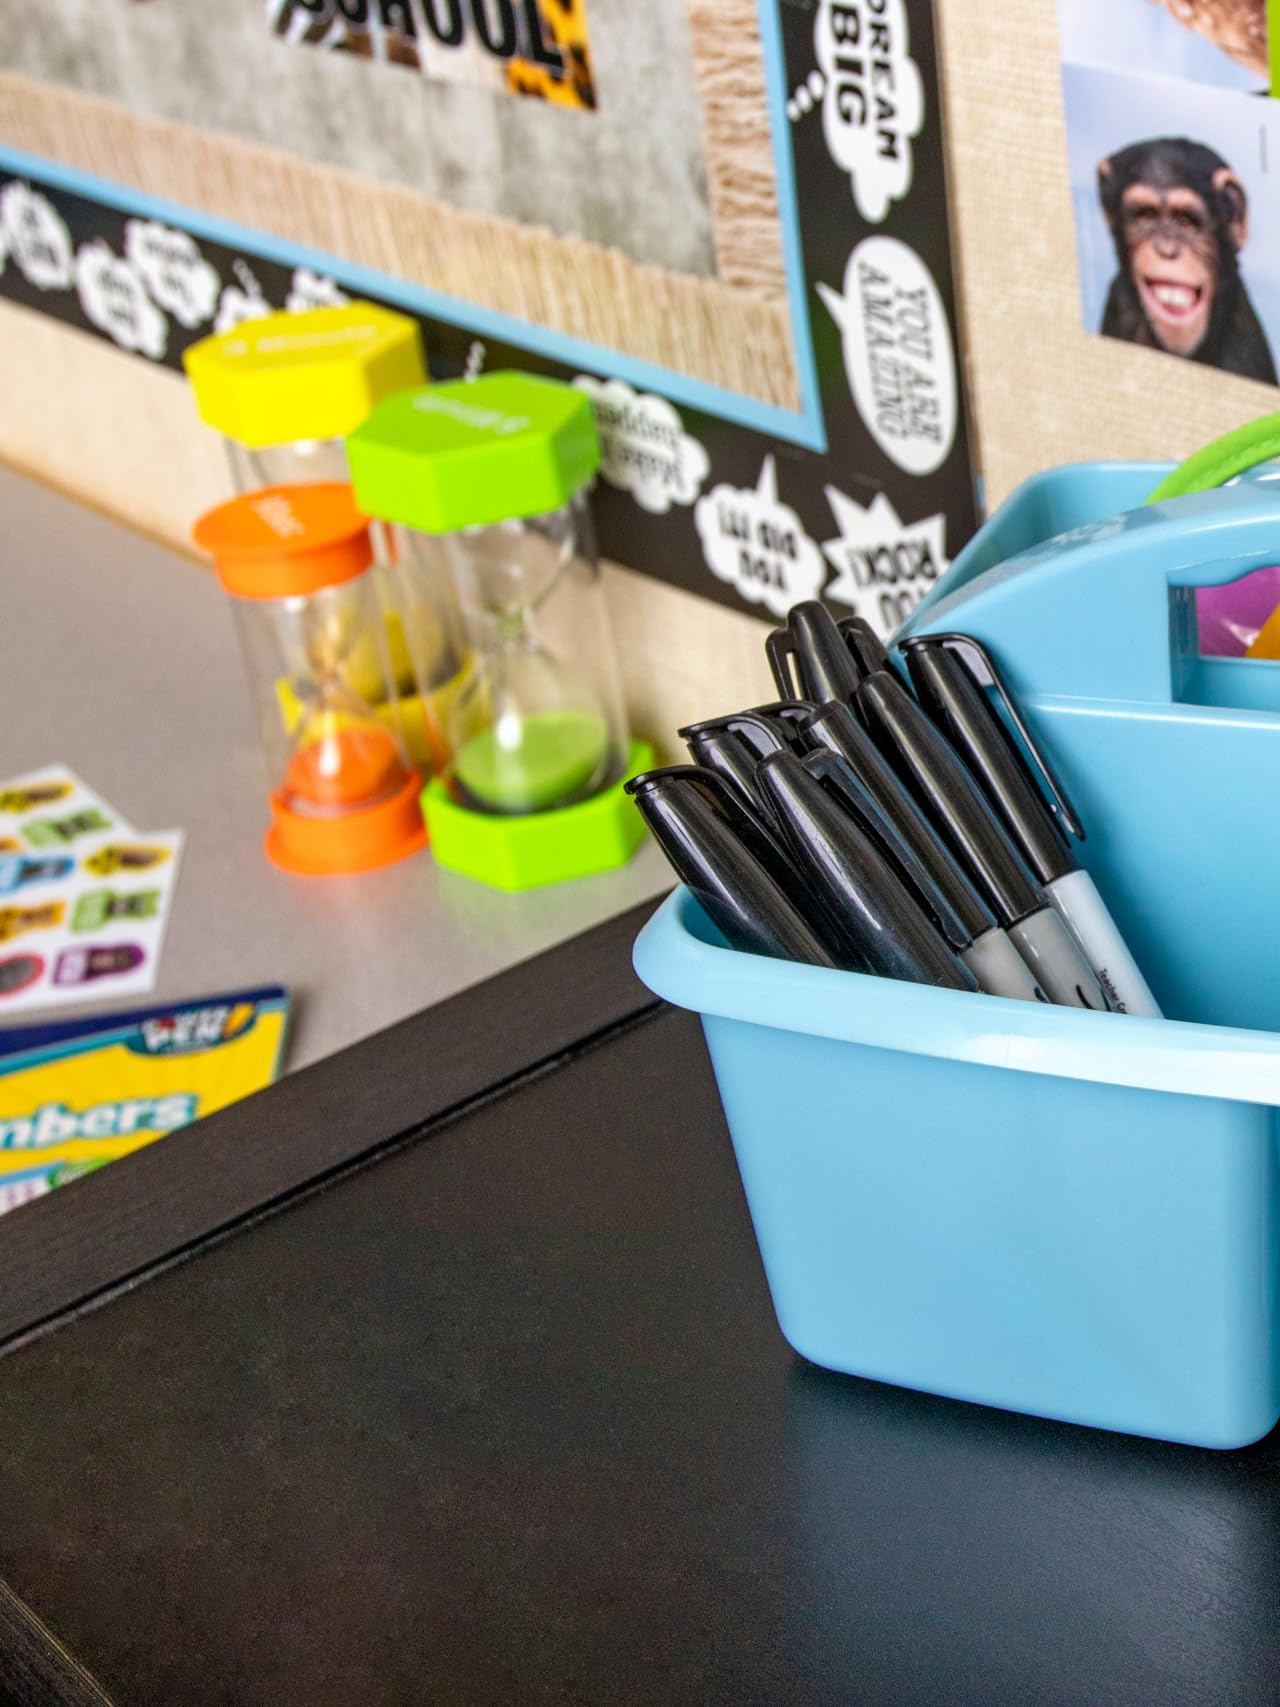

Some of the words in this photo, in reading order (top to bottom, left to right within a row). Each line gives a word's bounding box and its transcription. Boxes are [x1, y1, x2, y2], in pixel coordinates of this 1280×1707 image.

[303, 0, 565, 67] HOOL
[829, 3, 867, 127] BIG
[858, 260, 908, 439] AMAZING
[896, 284, 935, 363] YOU
[738, 548, 789, 592] YOU
[757, 520, 798, 563] DID
[849, 537, 939, 590] ROCK!
